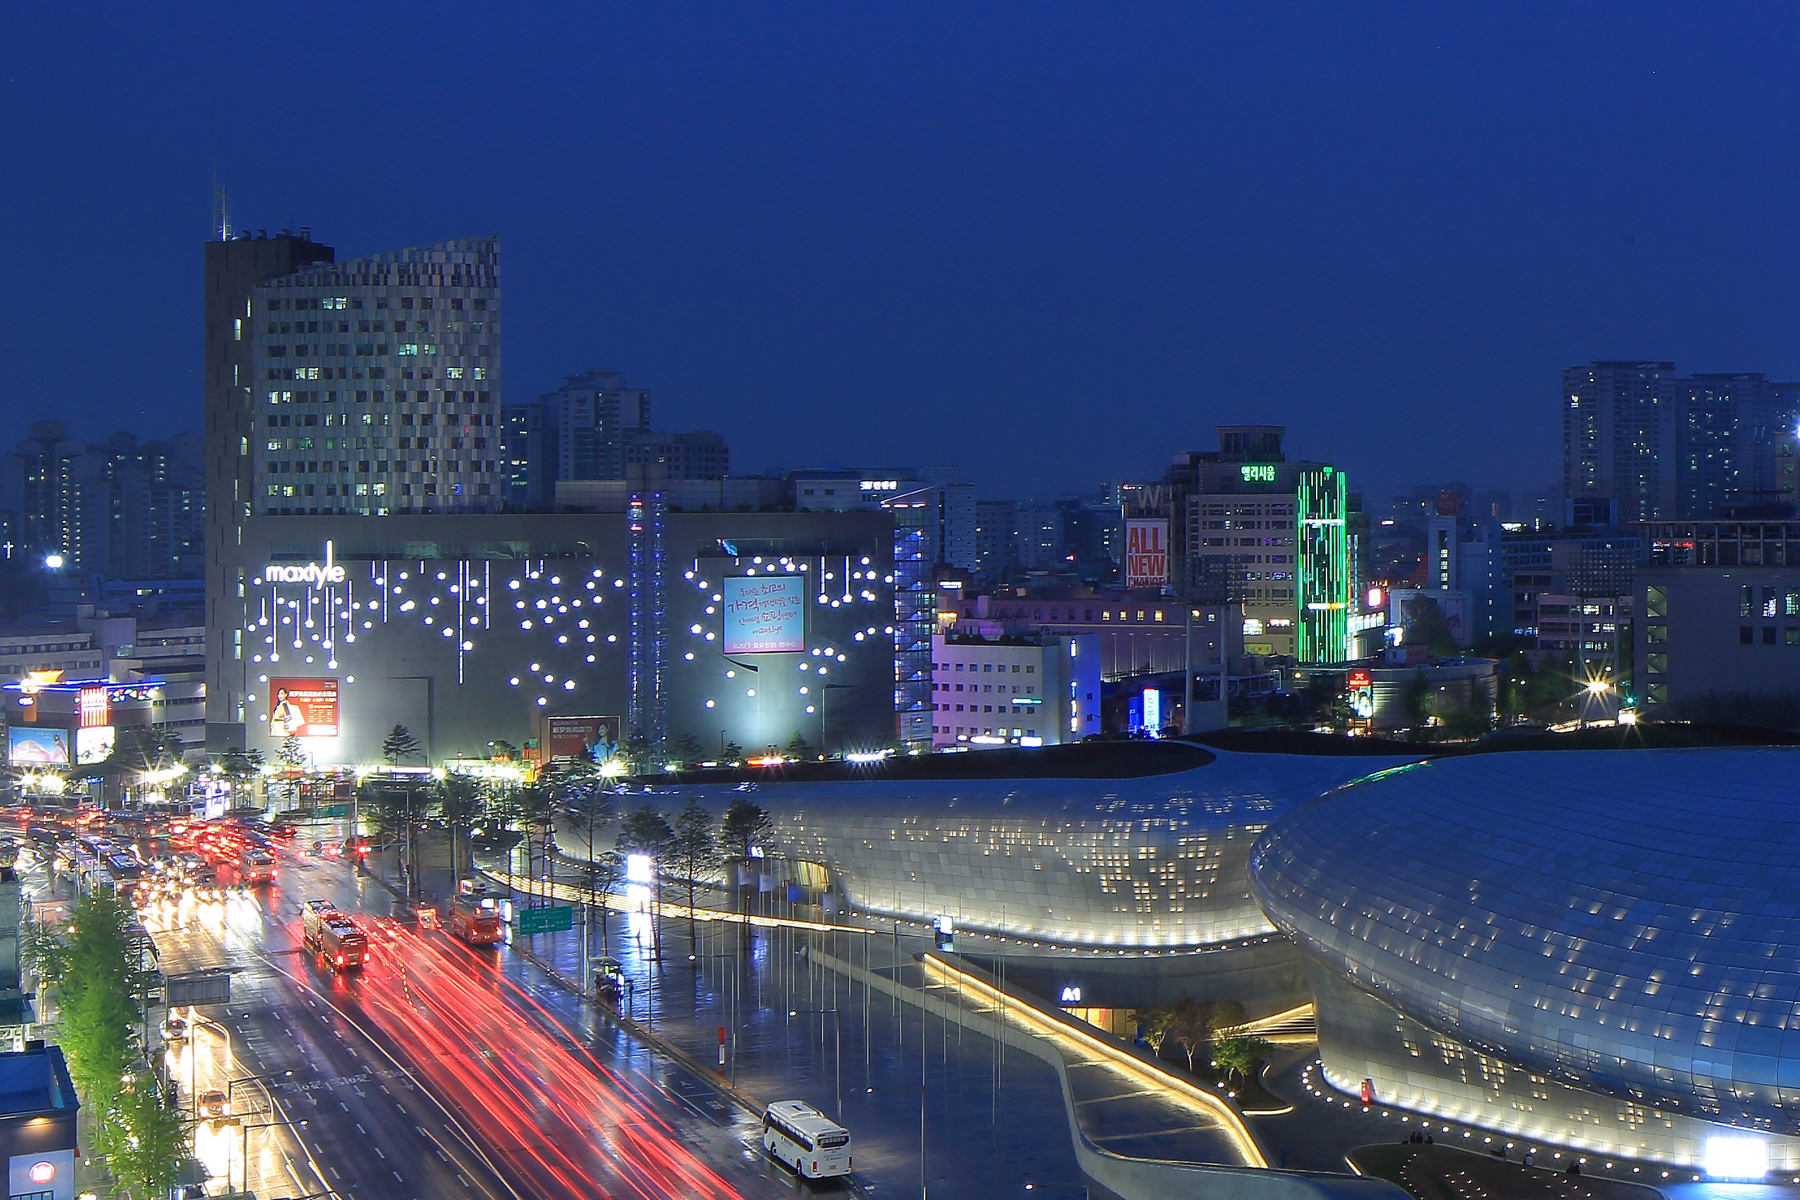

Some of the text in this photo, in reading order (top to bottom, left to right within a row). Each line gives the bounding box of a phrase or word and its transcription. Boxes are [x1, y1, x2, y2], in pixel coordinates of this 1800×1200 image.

[1128, 527, 1166, 554] ALL
[265, 539, 346, 591] maxtyle
[1128, 555, 1166, 576] NEW
[761, 583, 786, 595] 최고의
[1062, 986, 1081, 1001] A1
